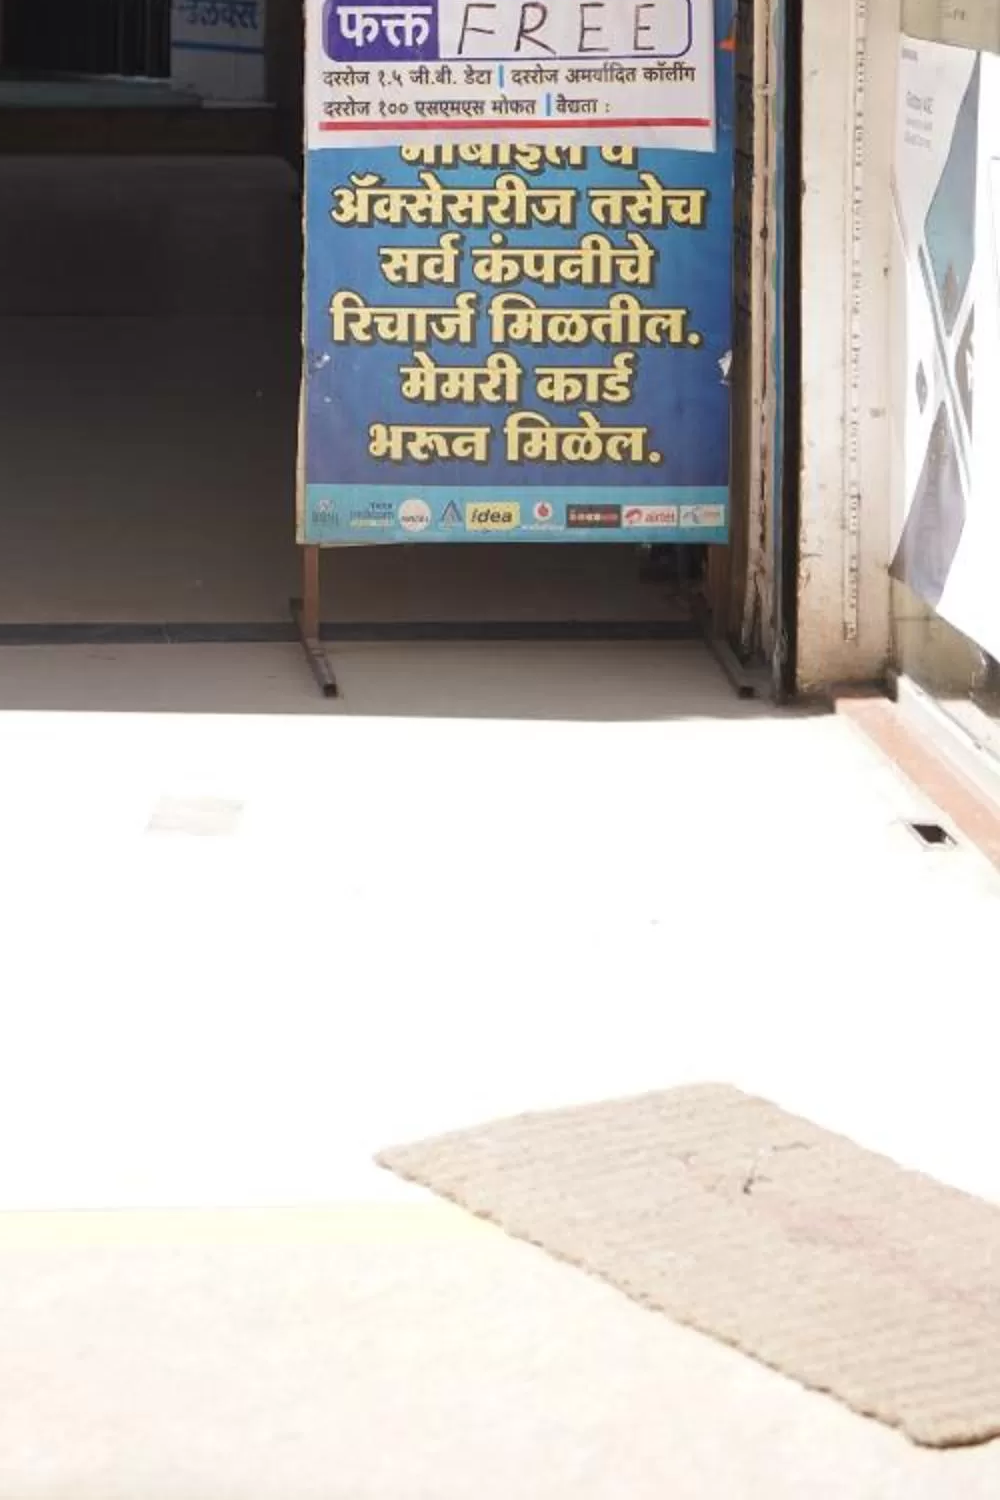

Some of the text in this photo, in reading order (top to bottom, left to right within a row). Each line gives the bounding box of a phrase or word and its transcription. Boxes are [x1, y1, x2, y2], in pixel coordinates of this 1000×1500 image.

[336, 4, 434, 48] फक्त
[456, 1, 657, 56] FREE
[322, 64, 371, 87] दररोज
[463, 66, 493, 86] डेटा
[510, 63, 559, 86] दररोज
[322, 94, 372, 116] दररोज
[414, 98, 485, 116] एसएमएस
[491, 94, 537, 115] मोफत
[588, 173, 708, 228] तसेच
[378, 232, 656, 286] सर्व कंपनीचे
[330, 291, 702, 347] रिचार्ज मिळतील.
[400, 352, 635, 404] मेमरी कार्ड
[369, 412, 663, 465] भरून मिळेल.
[470, 508, 514, 525] idea
